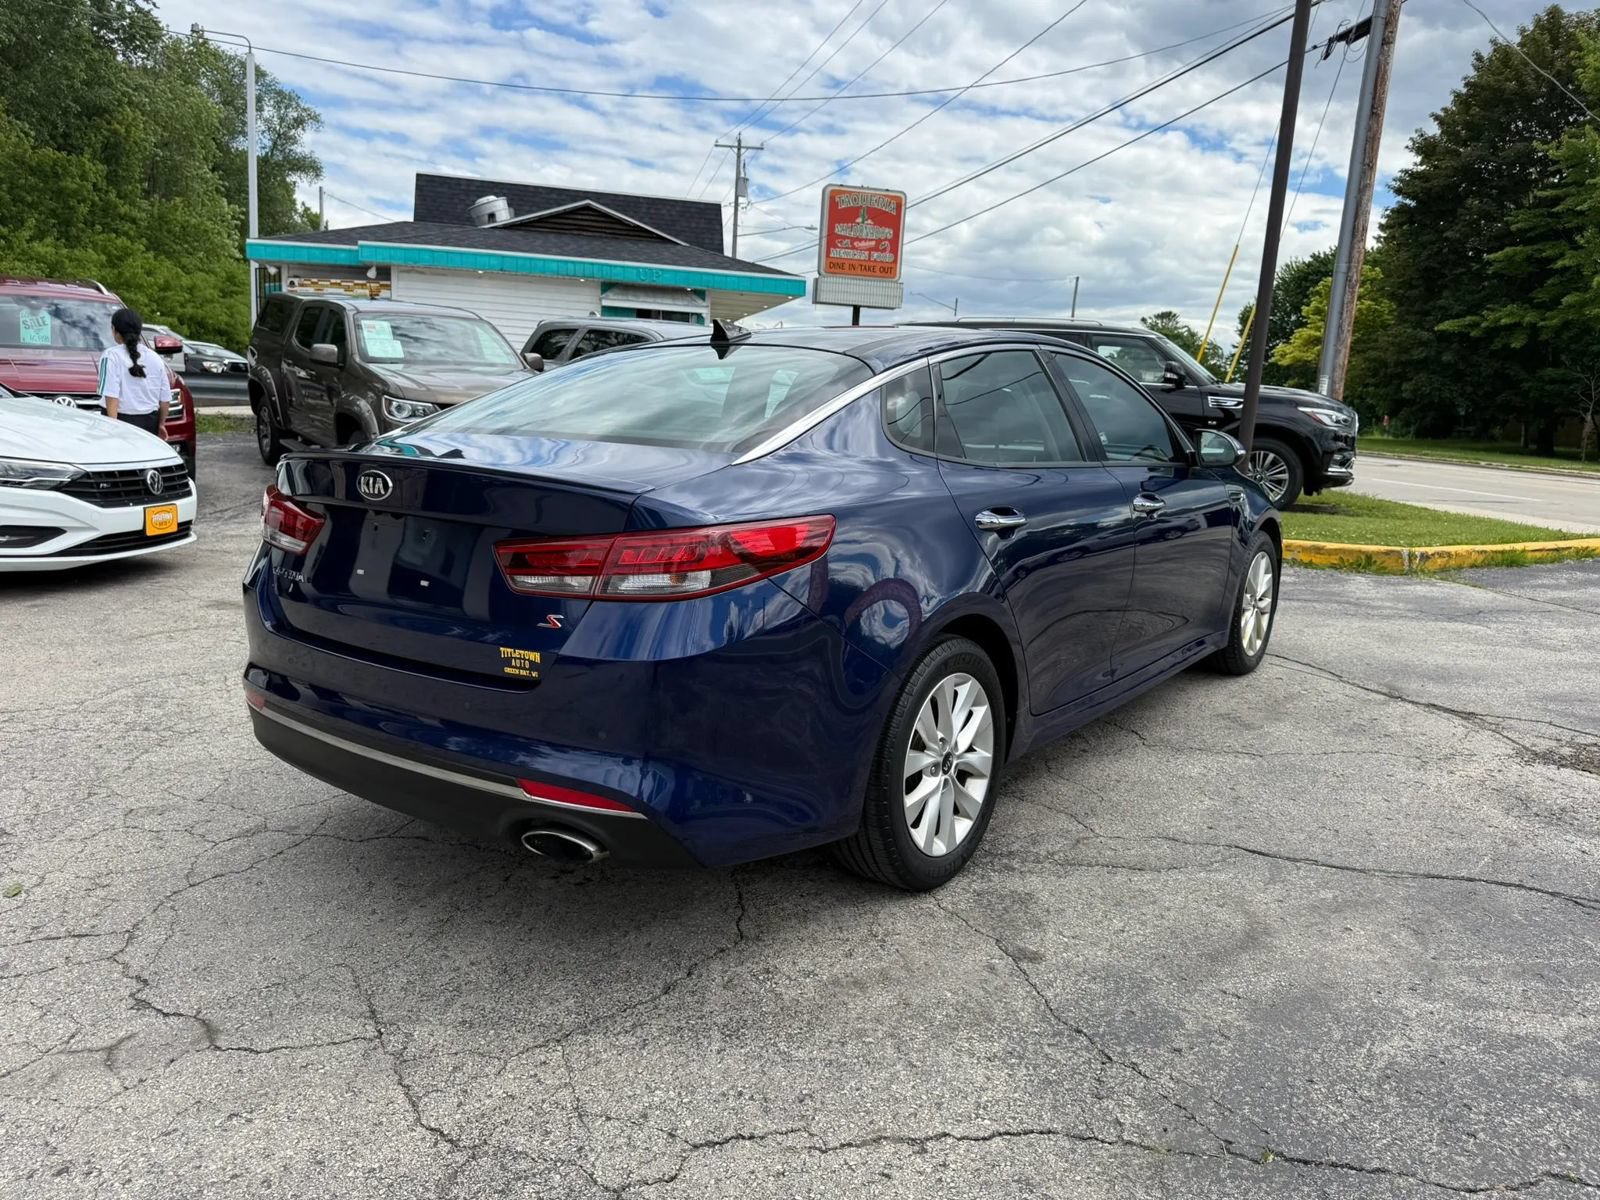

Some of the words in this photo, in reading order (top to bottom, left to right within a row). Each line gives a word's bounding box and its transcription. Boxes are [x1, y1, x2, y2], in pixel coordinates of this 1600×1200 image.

[836, 193, 897, 215] TAQUERIA
[829, 261, 846, 271] DINE
[879, 266, 894, 275] OUT
[22, 316, 49, 330] SALE
[360, 476, 385, 495] KIA
[499, 647, 541, 664] TITLETOWN
[511, 658, 530, 669] AUTO
